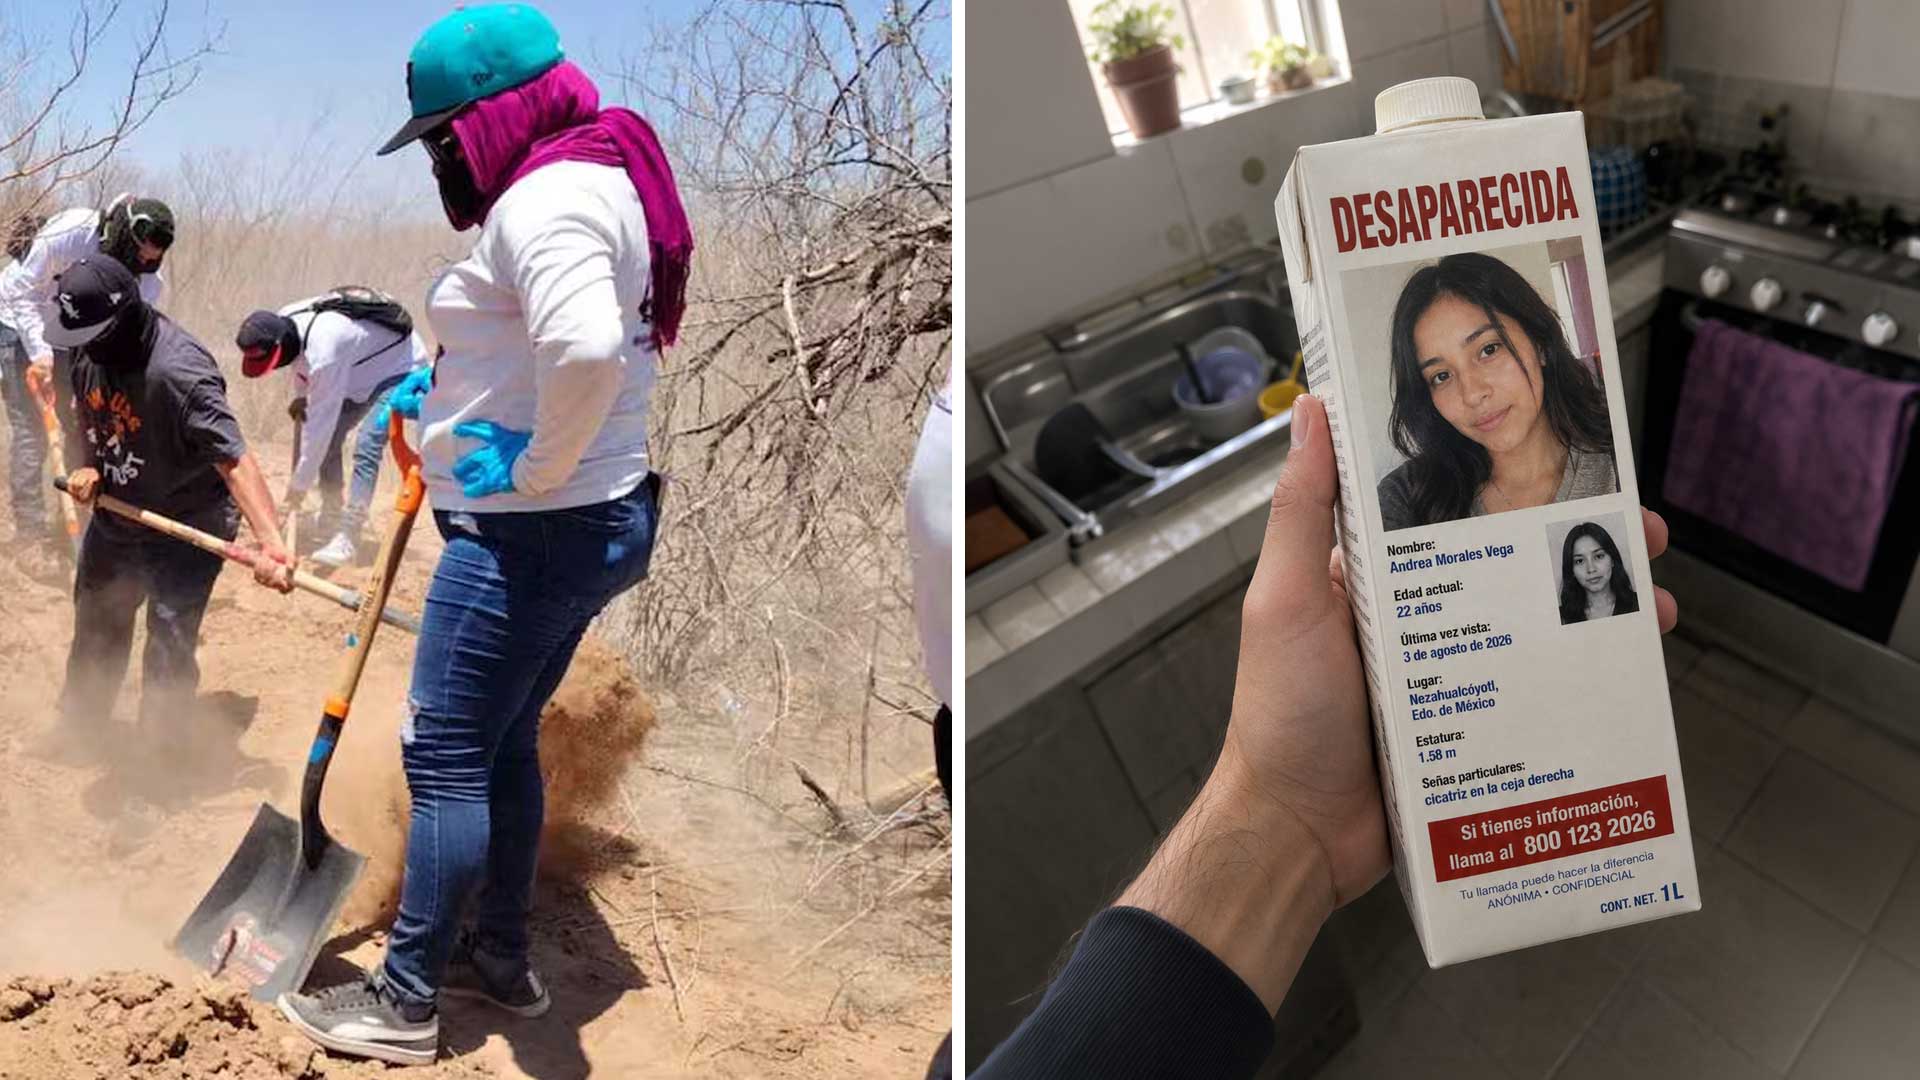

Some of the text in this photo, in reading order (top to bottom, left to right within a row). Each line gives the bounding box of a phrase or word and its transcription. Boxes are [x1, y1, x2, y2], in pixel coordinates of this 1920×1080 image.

[1330, 166, 1579, 253] DESAPARECIDA
[1387, 541, 1435, 556] Nombre:
[1390, 544, 1514, 573] Andrea Morales Vega
[1394, 581, 1463, 601] Edad actual:
[1397, 602, 1442, 618] 22 años
[1401, 623, 1491, 645] Última vez vista:
[1404, 634, 1512, 662] 3 de agosto de 2026
[1407, 675, 1442, 689] Lugar:
[1410, 680, 1499, 705] Nezahualcóyotl,
[1412, 698, 1495, 720] Edo. de México
[1416, 731, 1465, 747] Estatura:
[1419, 749, 1456, 763] 1.58 m
[1422, 762, 1525, 789] Señas particulares:
[1425, 769, 1574, 806] cicatriz en la ceja derecha
[1461, 794, 1639, 840] Si tienes información,
[1450, 810, 1656, 870] llama al 800 123 2026
[1460, 851, 1654, 900] Tu llamada puede hacer la diferencia
[1487, 870, 1635, 910] ANÓNIMA CONFIDENCIAL
[1600, 899, 1631, 913] CONT.
[1634, 893, 1657, 906] NET.
